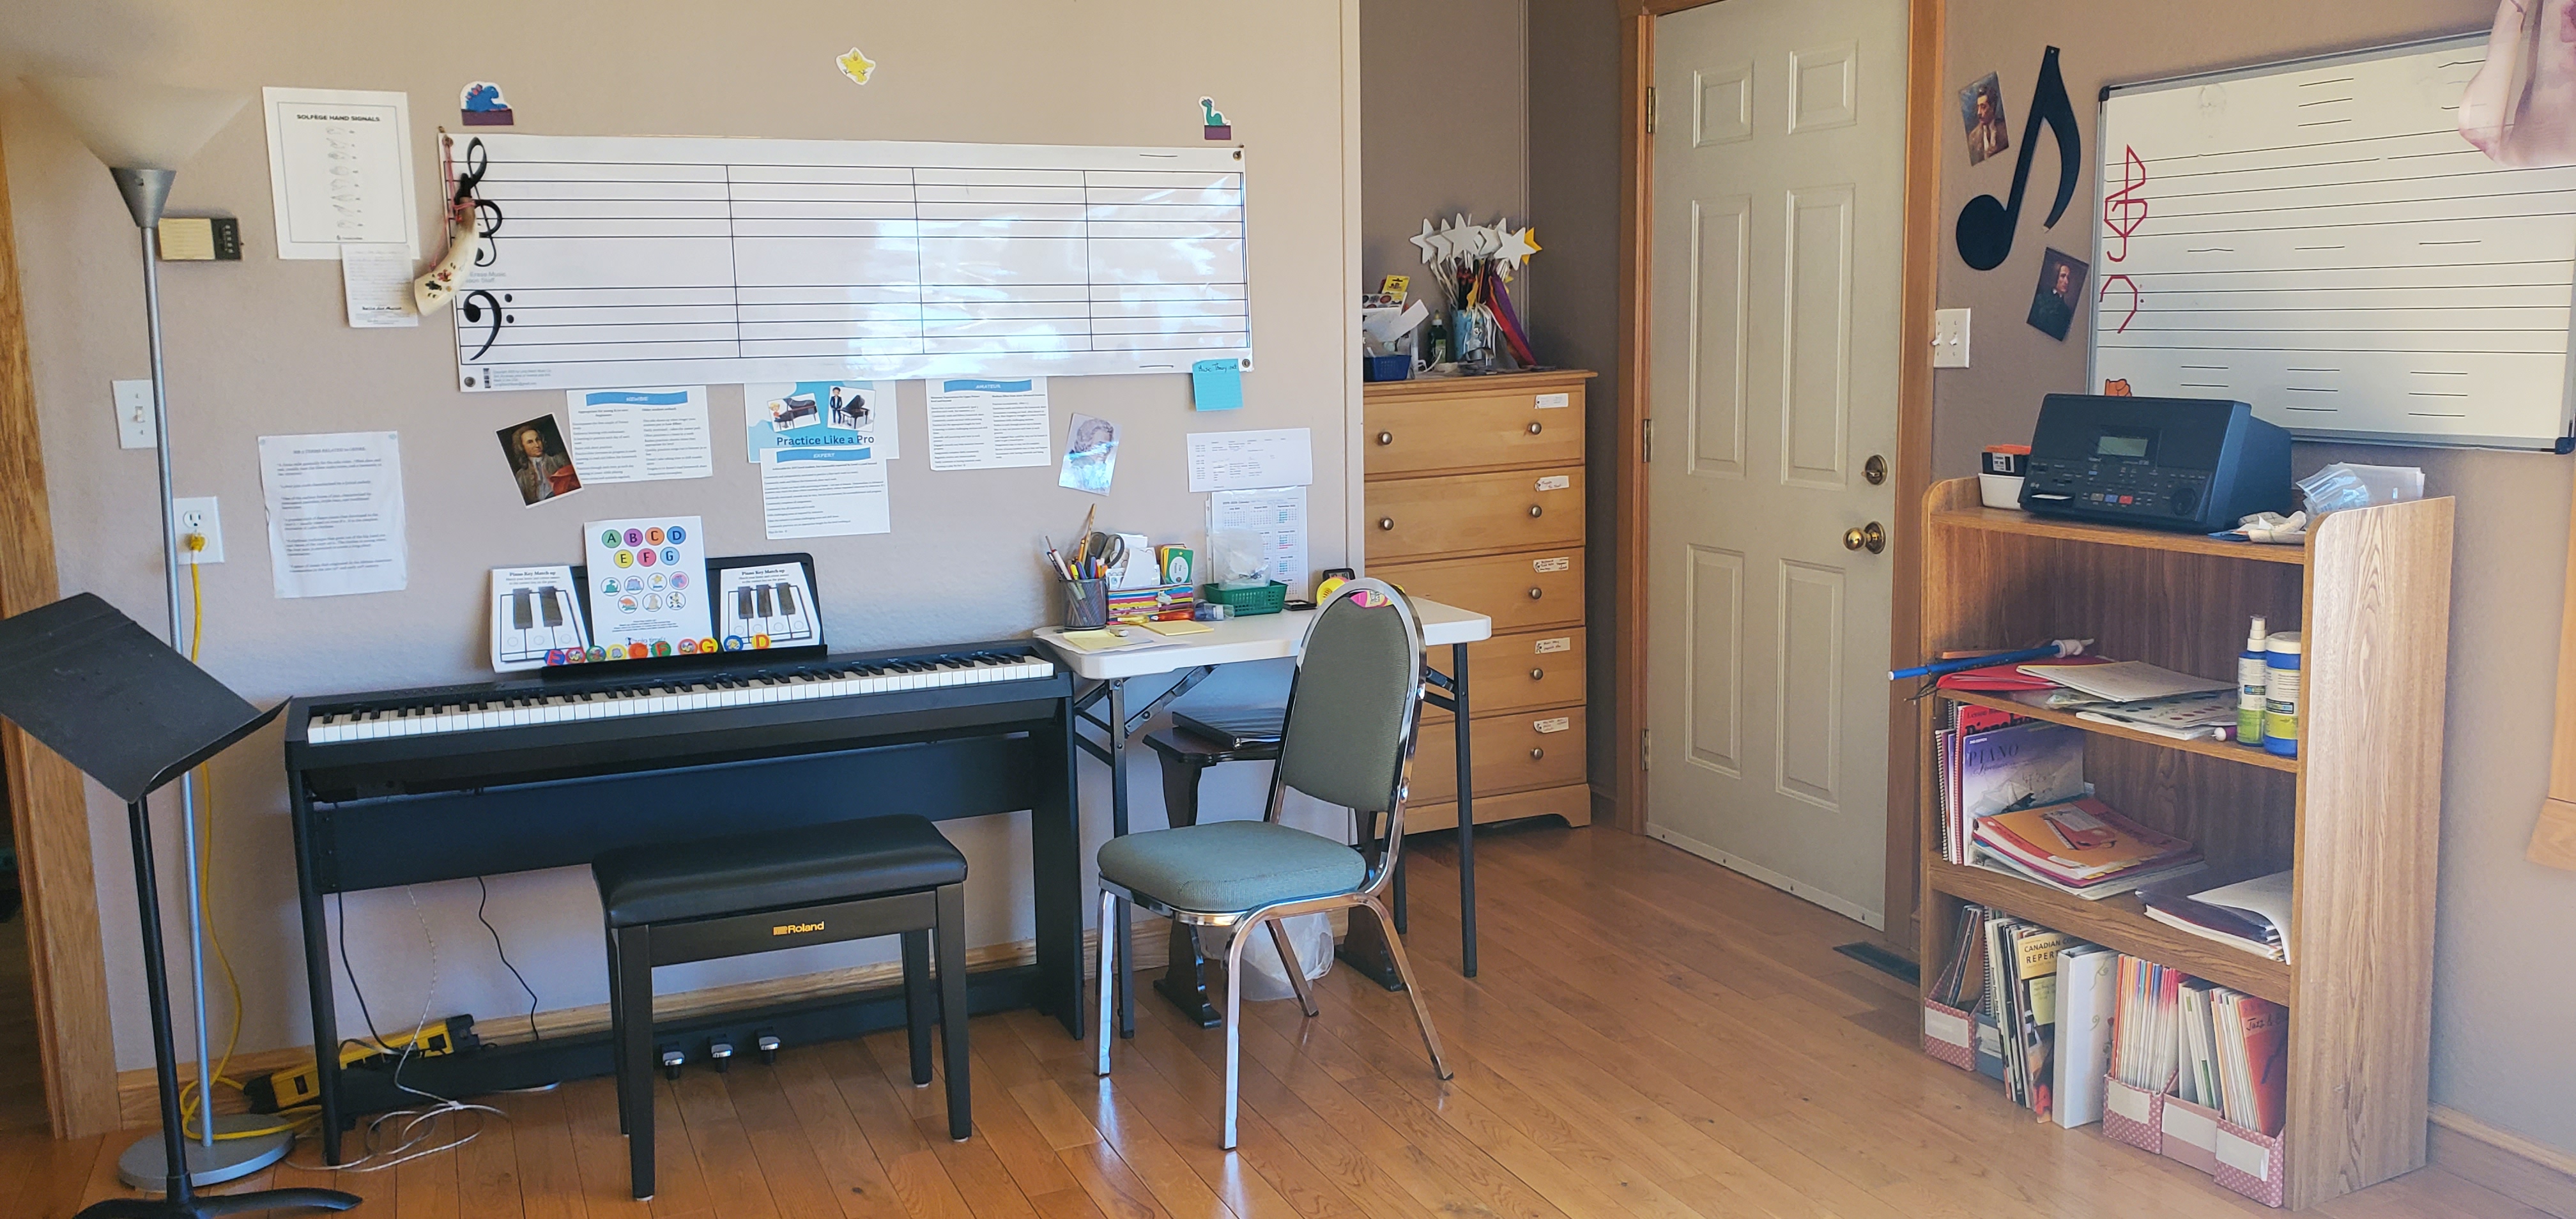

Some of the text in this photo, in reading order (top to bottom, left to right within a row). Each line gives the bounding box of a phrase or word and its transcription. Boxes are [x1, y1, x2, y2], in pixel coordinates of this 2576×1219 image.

[777, 436, 821, 446] Practice
[824, 435, 846, 445] Like
[857, 435, 875, 443] Pro
[607, 530, 682, 543] A B C D
[620, 550, 673, 564] E F G
[547, 650, 563, 666] E
[656, 641, 667, 657] F
[699, 639, 714, 653] G
[756, 634, 769, 649] D
[1968, 743, 2019, 767] PIANO
[788, 920, 825, 934] Roland
[2024, 940, 2061, 953] CANADIAN
